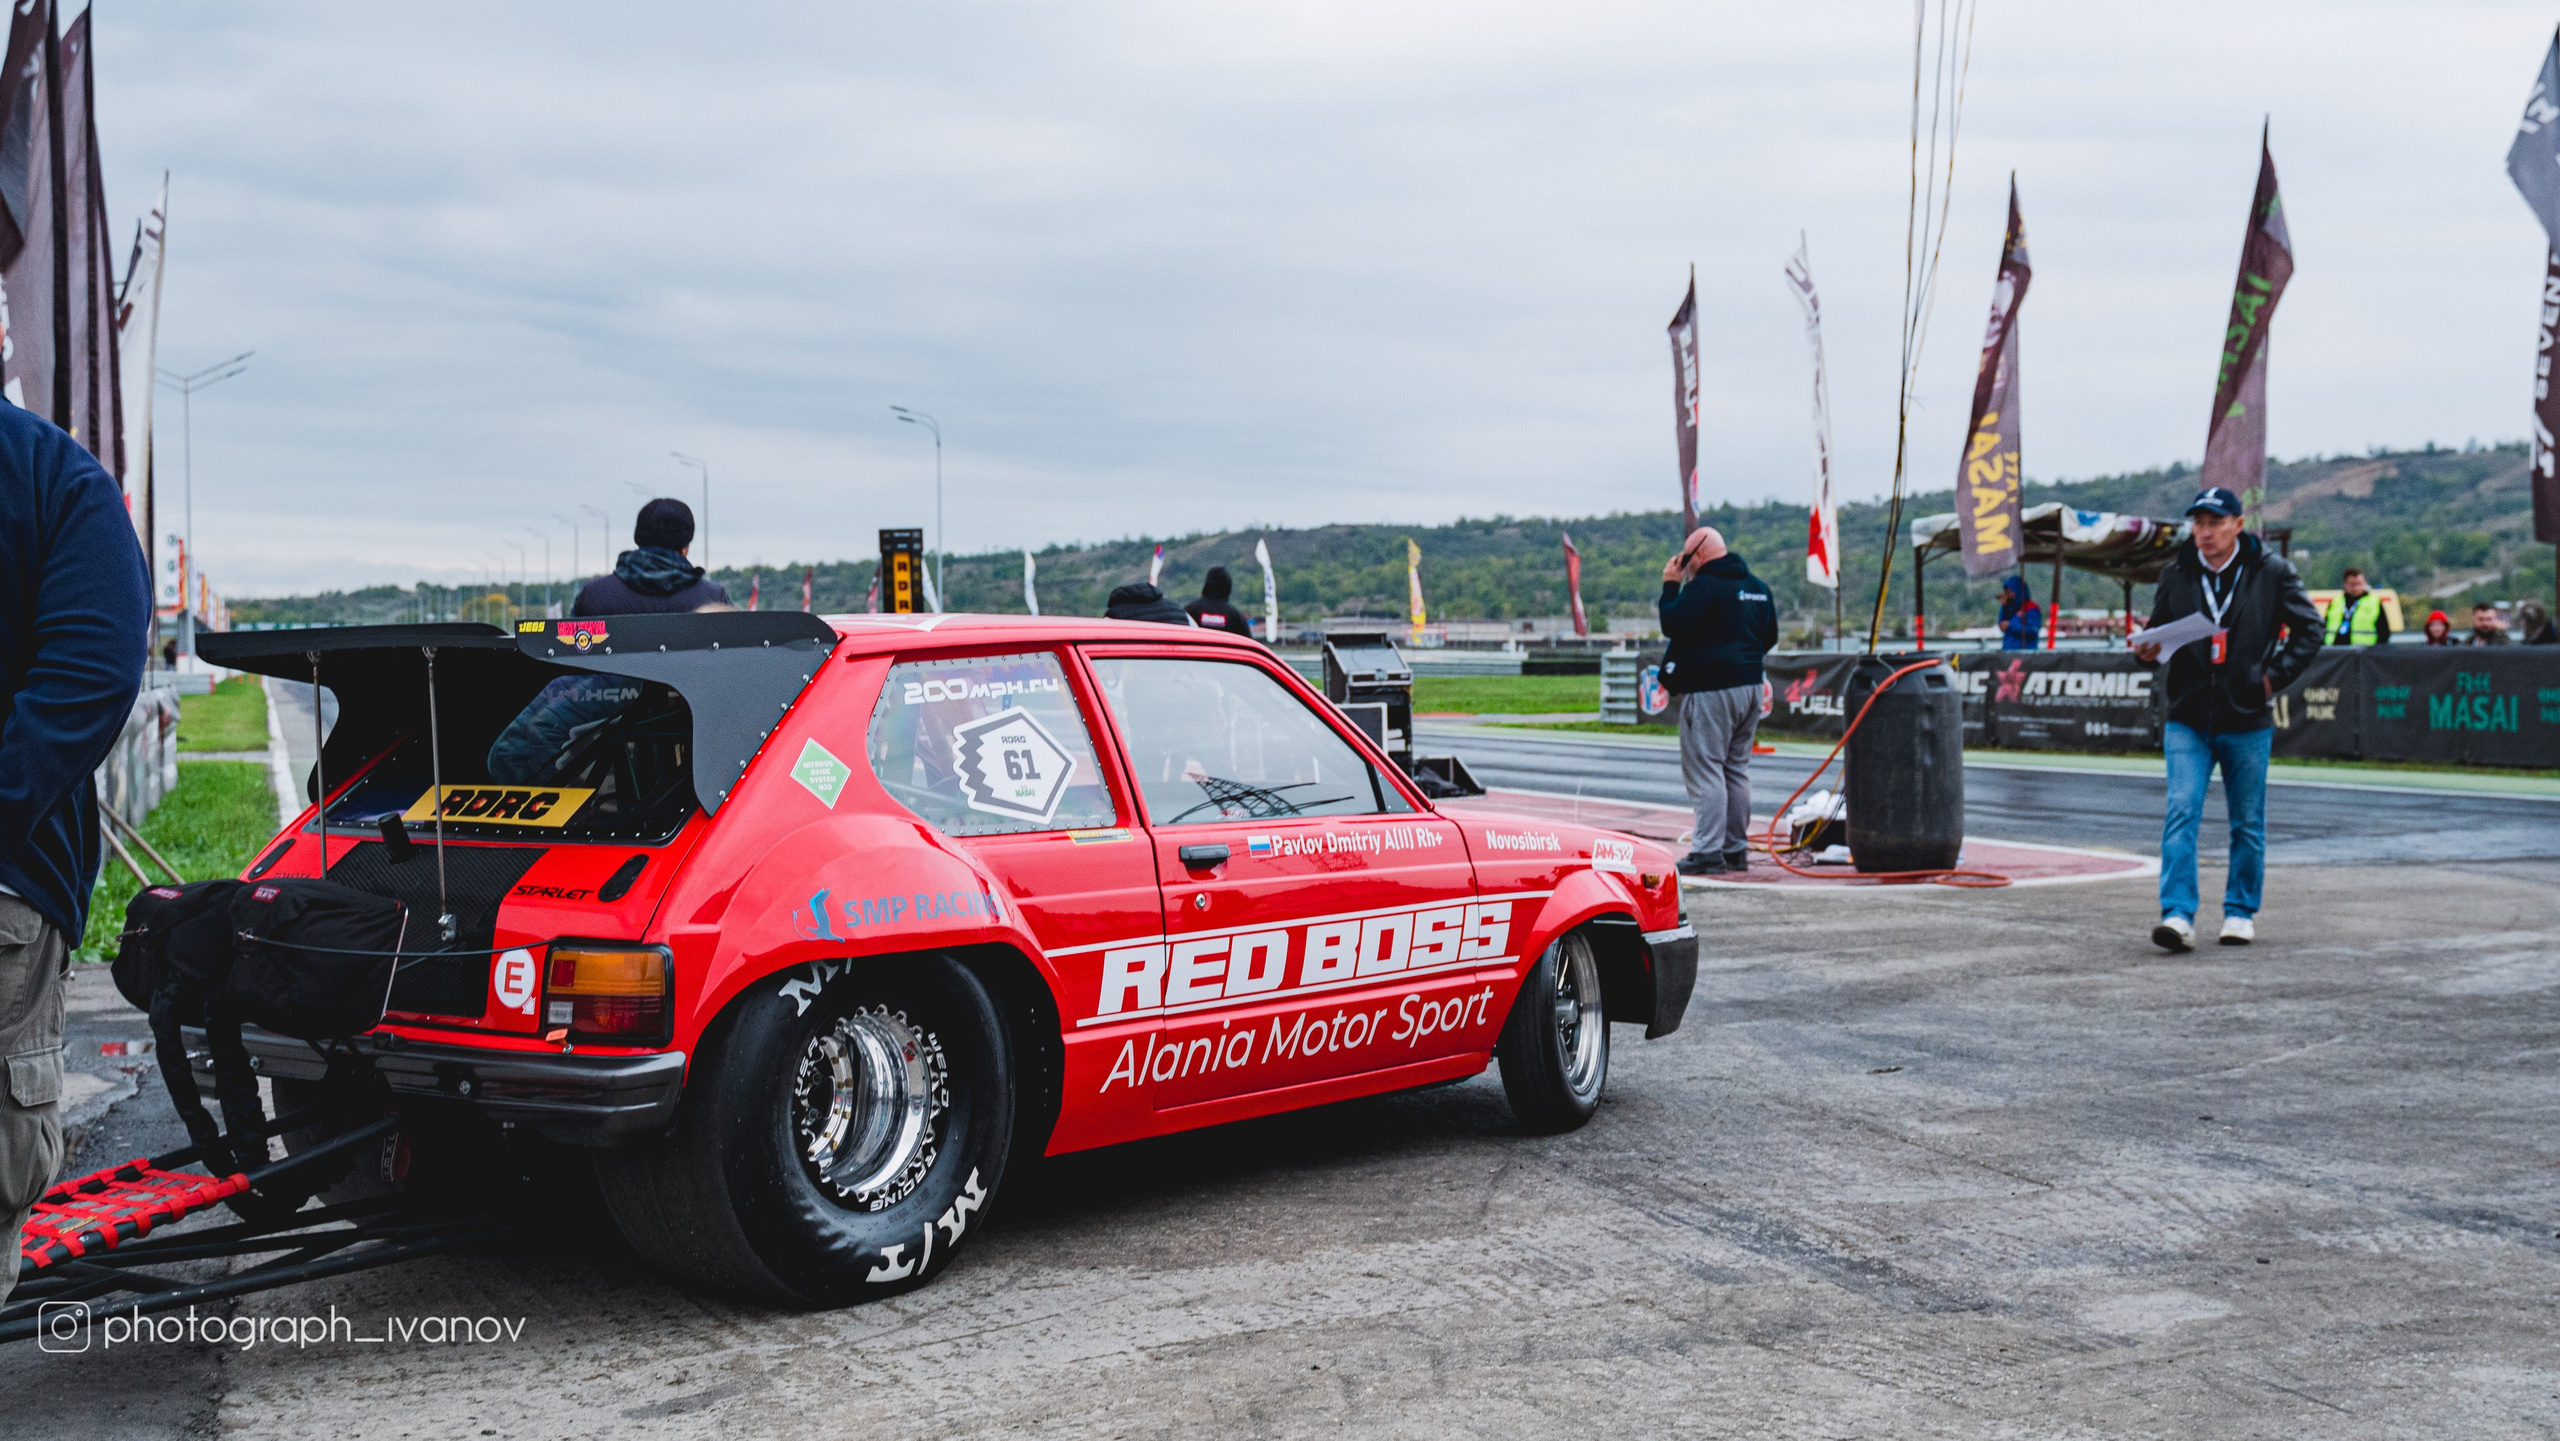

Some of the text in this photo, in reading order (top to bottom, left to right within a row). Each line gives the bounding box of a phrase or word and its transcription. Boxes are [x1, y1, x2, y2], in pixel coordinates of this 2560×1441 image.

[2022, 671, 2153, 697] ATOMIC
[2429, 694, 2519, 732] MASAI
[803, 760, 834, 769] NITROUS
[809, 776, 836, 784] SYSTEM
[810, 768, 831, 776] OXIDE
[1003, 749, 1041, 781] 61
[430, 789, 560, 820] RDRC
[1272, 834, 1323, 856] Pavlov
[1327, 829, 1380, 855] Dmitriy
[1417, 826, 1443, 847] Rh+
[1487, 829, 1562, 852] Novosibirsk
[513, 885, 595, 900] STARLET
[843, 891, 1004, 927] SMP RACING
[1097, 901, 1512, 1016] RED BOSS
[504, 962, 525, 994] E
[1100, 985, 1495, 1094] Alania Motor Sport
[927, 1031, 950, 1108] WELD
[869, 1146, 937, 1212] RACING
